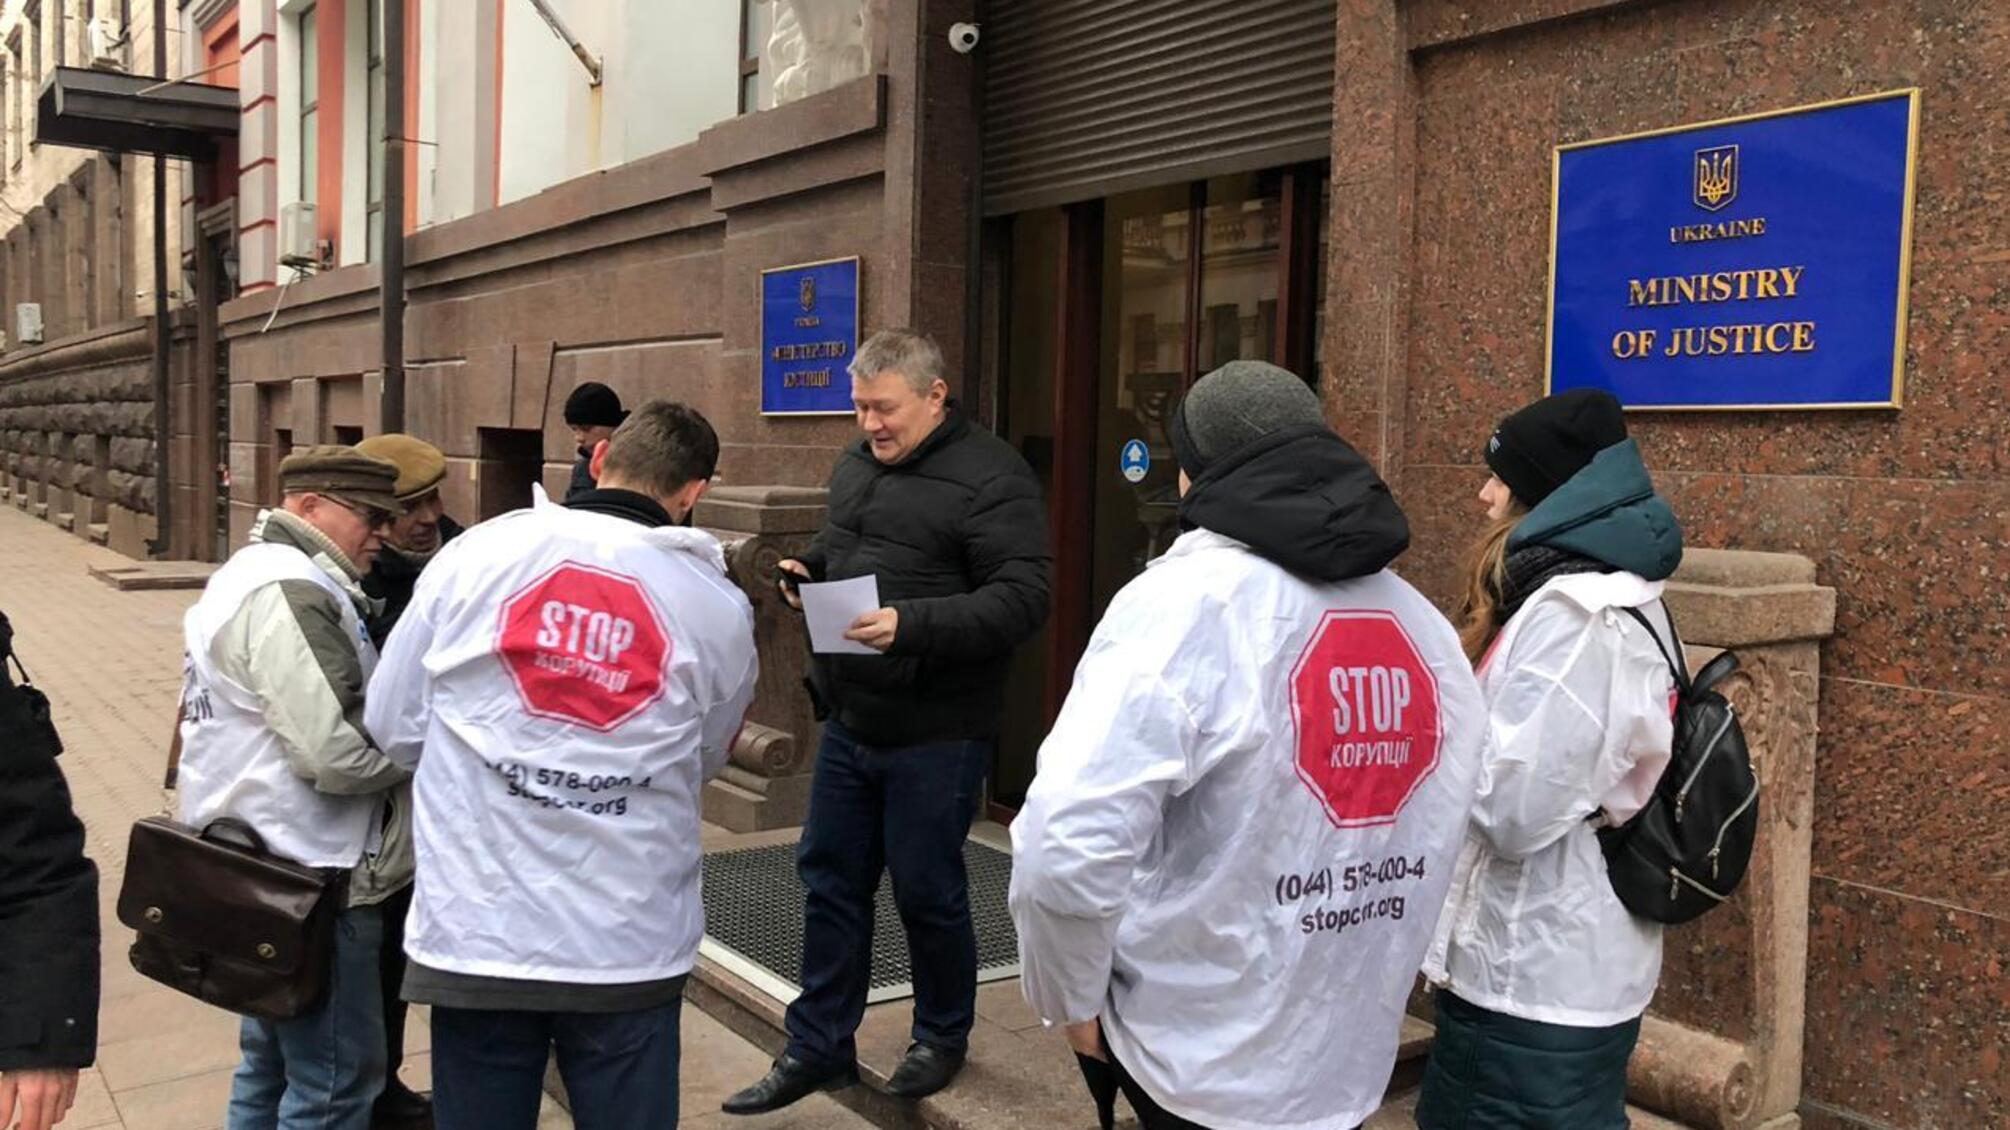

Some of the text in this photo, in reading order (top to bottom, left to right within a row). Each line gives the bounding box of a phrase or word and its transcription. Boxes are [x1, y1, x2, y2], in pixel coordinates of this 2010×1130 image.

[1670, 218, 1766, 243] UKRAINE
[1627, 266, 1805, 306] MINISTRY
[1612, 321, 1816, 359] OF JUSTICE
[536, 600, 635, 664] STOP
[1329, 665, 1411, 735] STOP
[1331, 736, 1413, 768] КОРУПЦІЇ
